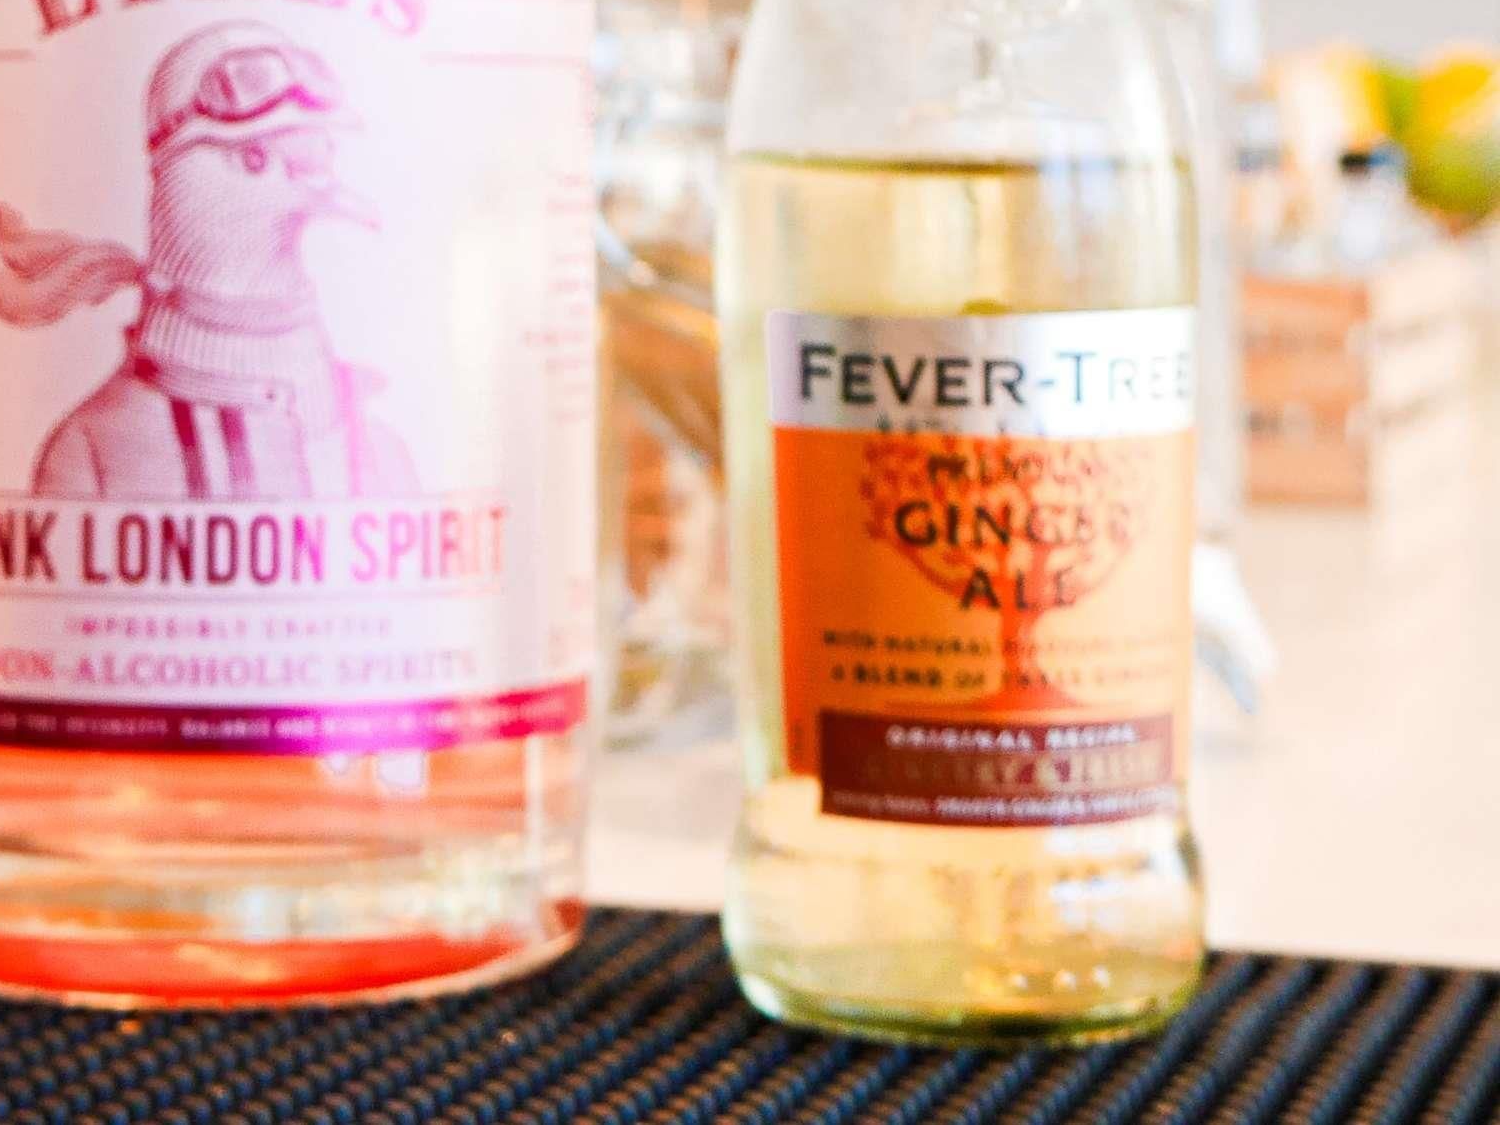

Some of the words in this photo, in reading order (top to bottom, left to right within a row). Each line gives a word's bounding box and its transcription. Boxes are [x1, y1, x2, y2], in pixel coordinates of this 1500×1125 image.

[799, 341, 1190, 408] FEVER-TREE
[77, 512, 327, 586] LONDON
[350, 503, 508, 582] SPIRIT
[958, 566, 1079, 611] ALE
